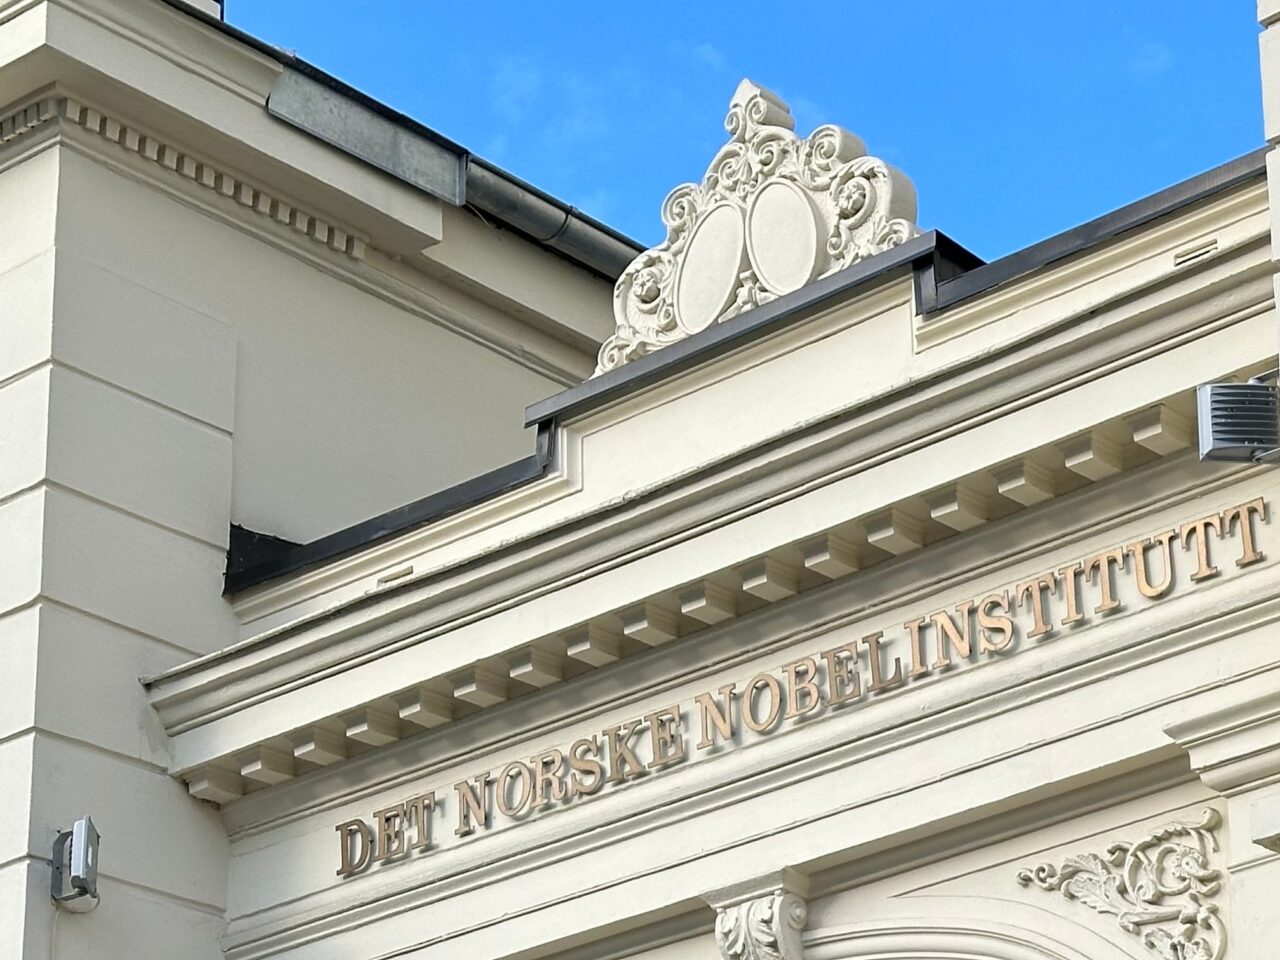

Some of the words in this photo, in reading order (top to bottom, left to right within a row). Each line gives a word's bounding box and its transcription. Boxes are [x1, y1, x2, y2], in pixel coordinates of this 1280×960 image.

[335, 791, 437, 877] DET
[454, 704, 685, 836] NORSKE
[695, 496, 1267, 750] NOBELINSTITUTT
